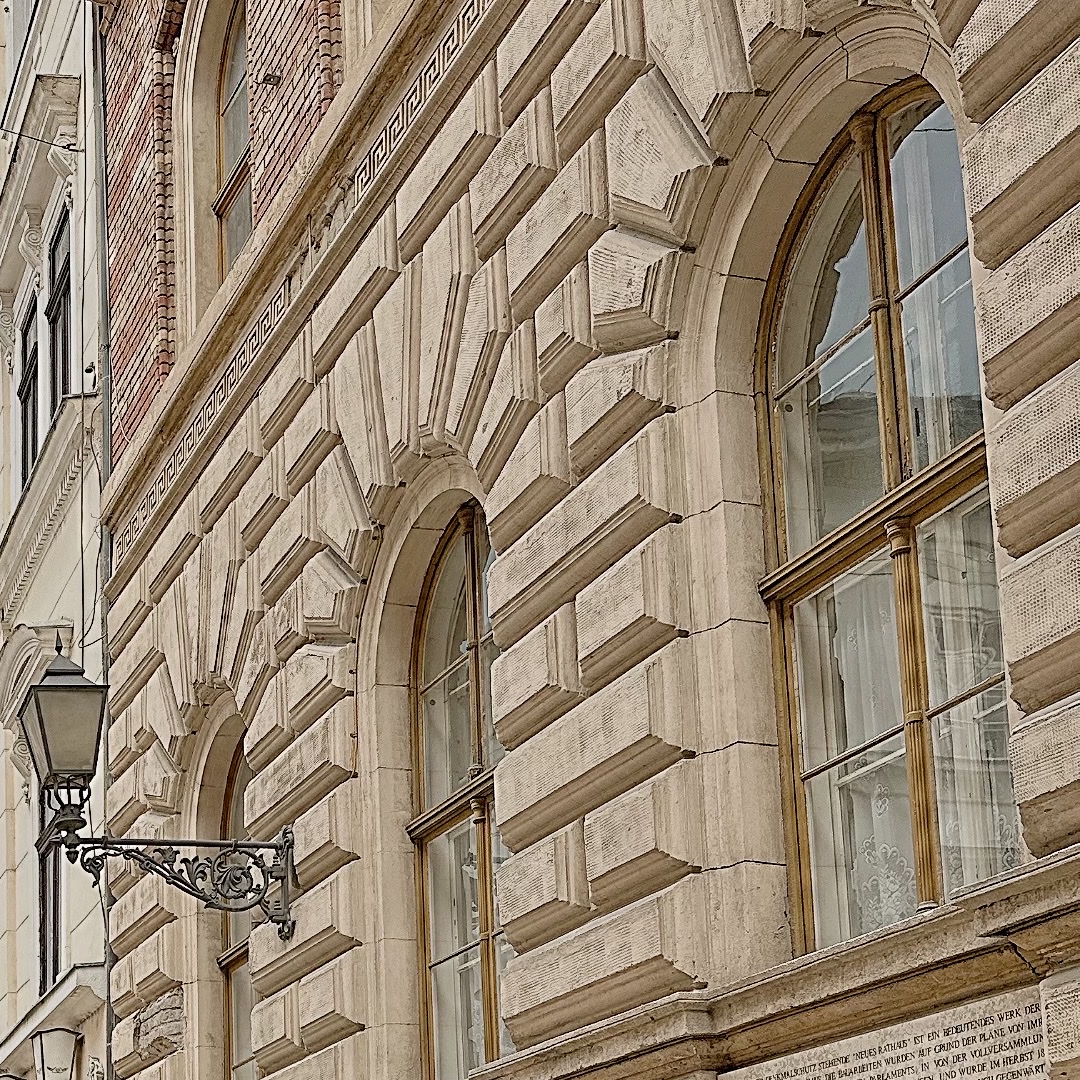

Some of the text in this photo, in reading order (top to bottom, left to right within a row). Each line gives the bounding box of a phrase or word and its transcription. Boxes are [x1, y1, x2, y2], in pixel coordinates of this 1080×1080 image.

[884, 1051, 914, 1066] WURDEN
[918, 1047, 931, 1058] AUF
[933, 1039, 959, 1054] GRUND
[962, 1035, 976, 1047] DER
[1008, 1023, 1024, 1035] VON
[1027, 1018, 1042, 1030] IMR
[913, 1034, 923, 1045] IST
[927, 1030, 939, 1041] EIN
[997, 1008, 1020, 1023] WERK
[1024, 1003, 1041, 1016] DER
[921, 1061, 929, 1071] IN
[934, 1057, 948, 1068] VON
[952, 1052, 967, 1064] DER
[970, 1033, 1043, 1059] VOLLVERSAMMLUN
[939, 1069, 956, 1080] UND
[958, 1062, 987, 1077] WURDE
[990, 1059, 1000, 1069] IM
[1002, 1051, 1033, 1066] HERBST
